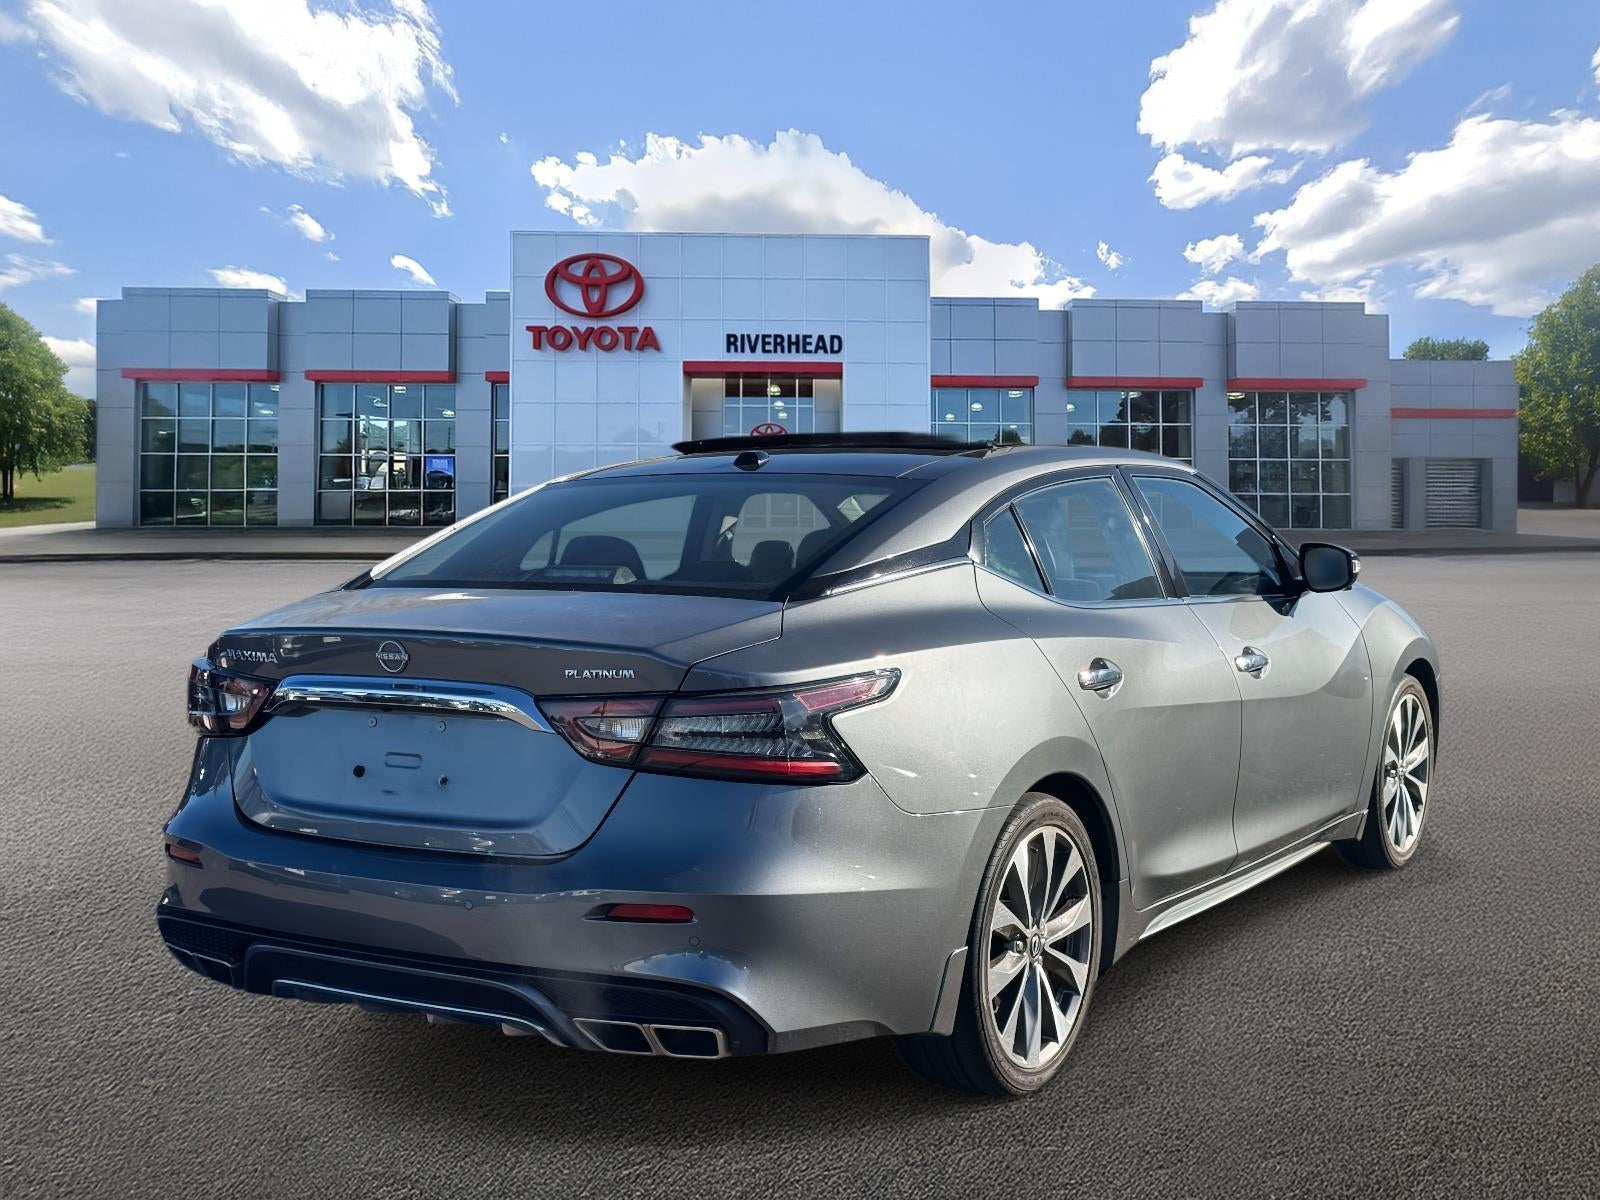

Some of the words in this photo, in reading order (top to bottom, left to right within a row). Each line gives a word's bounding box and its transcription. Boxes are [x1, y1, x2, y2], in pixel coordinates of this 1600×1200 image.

[526, 326, 661, 352] TOYOTA
[725, 333, 843, 354] RIVERHEAD
[226, 648, 278, 663] MAXIMA
[375, 652, 408, 660] NISSAN
[564, 669, 635, 678] PLATINUM
